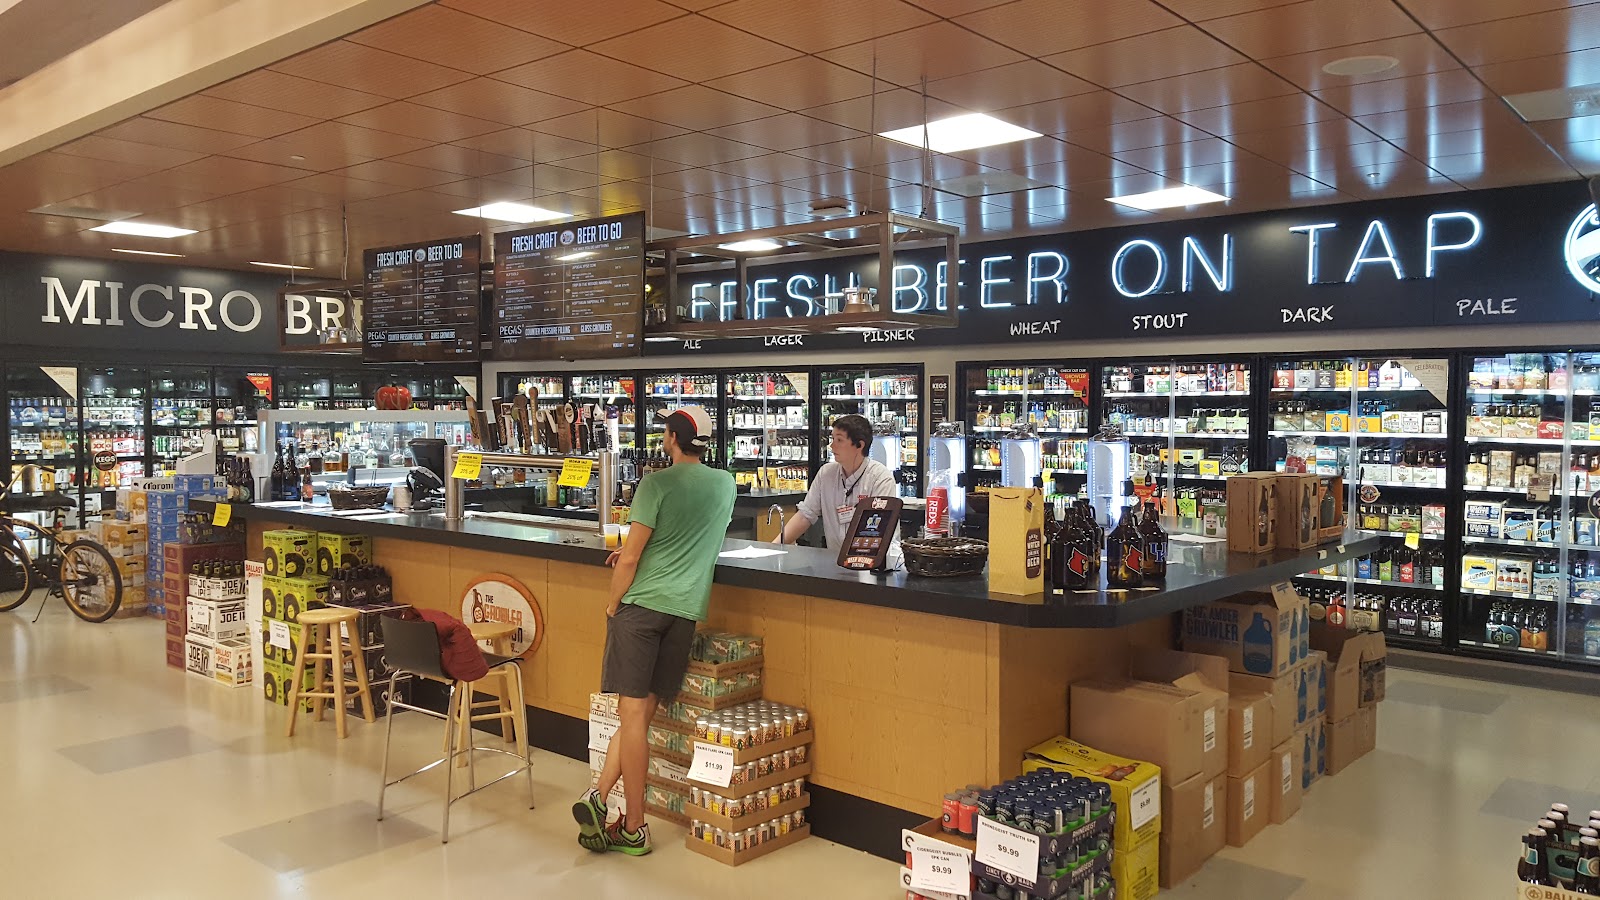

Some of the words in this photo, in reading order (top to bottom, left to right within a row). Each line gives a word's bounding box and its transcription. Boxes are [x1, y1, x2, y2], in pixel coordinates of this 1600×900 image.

[511, 235, 533, 253] FRESH
[535, 231, 558, 249] CRAFT
[577, 225, 596, 244] BEER
[598, 224, 609, 242] TO
[610, 222, 622, 240] GO
[377, 252, 394, 267] FRESH
[395, 249, 413, 264] CRAFT
[427, 245, 443, 262] BEER
[444, 244, 453, 260] TO
[453, 243, 463, 258] GO
[892, 252, 1067, 313] BEER
[1111, 233, 1232, 297] ON
[1289, 211, 1482, 285] TAP
[41, 276, 261, 333] MICRO
[525, 327, 540, 336] COUNTER
[540, 326, 557, 335] PRESSURE
[592, 323, 613, 333] GROWLERS
[683, 339, 701, 350] ALE
[764, 334, 803, 346] LAGER
[863, 329, 915, 343] PILSNER
[1010, 320, 1061, 336] WHEAT
[1132, 312, 1188, 330] STOUT
[1280, 304, 1334, 324] DARK
[1456, 297, 1518, 316] PALE
[1414, 363, 1445, 371] CELEBRATION
[932, 382, 947, 390] KEGS
[95, 455, 116, 463] KEGS
[928, 500, 938, 525] REDS
[1027, 541, 1040, 549] WATER
[1027, 556, 1040, 568] BEER
[246, 564, 263, 573] BALLAST
[222, 580, 238, 589] JOE
[485, 595, 494, 604] THE
[220, 612, 237, 623] JOE
[484, 604, 523, 626] GROWLER
[1186, 619, 1238, 641] GROWLER
[189, 645, 200, 660] JOE
[216, 647, 232, 658] BALLAST
[217, 655, 230, 665] POINT
[705, 761, 723, 771] $11.99
[981, 821, 1008, 835] RHINEGEIST
[1009, 832, 1026, 841] TRUTH
[916, 846, 941, 854] CIDERGEIST
[942, 850, 962, 858] BUBBLES
[997, 844, 1020, 858] $9.99
[931, 865, 952, 875] $9.99
[985, 865, 1000, 876] CINCY
